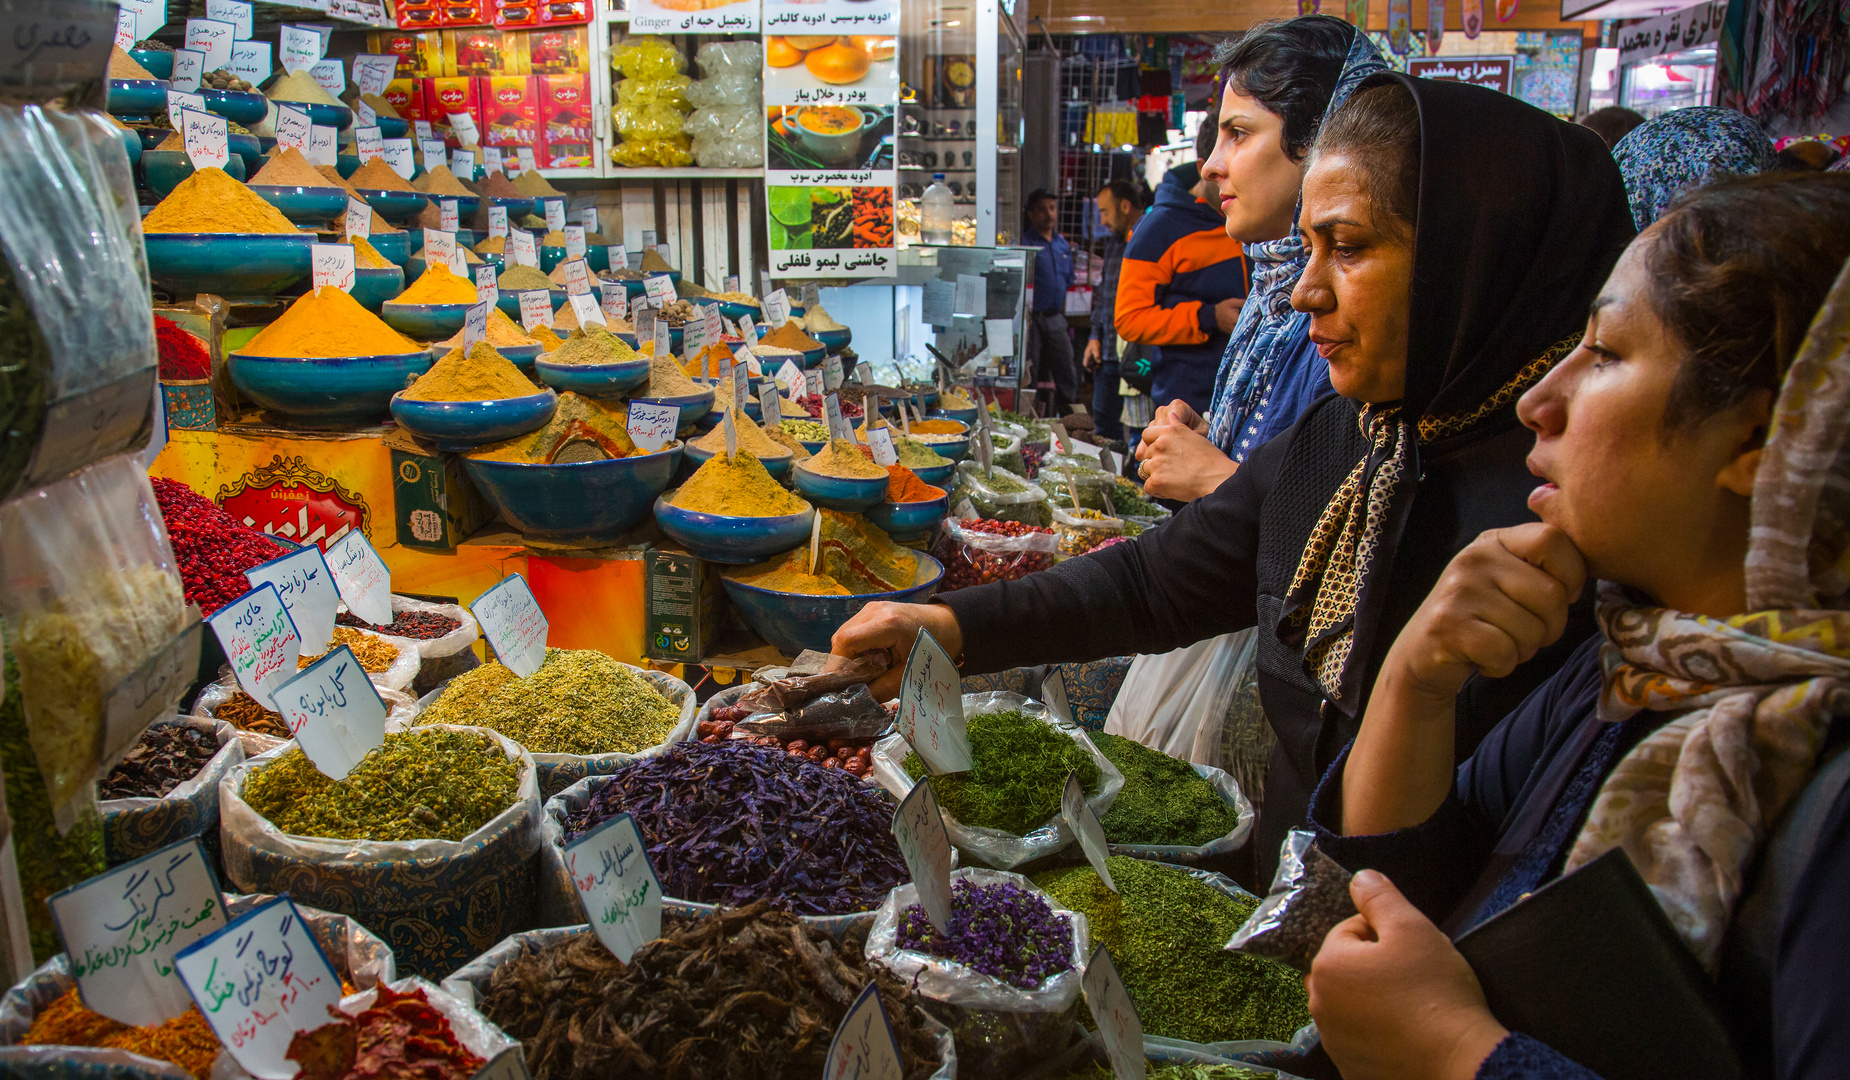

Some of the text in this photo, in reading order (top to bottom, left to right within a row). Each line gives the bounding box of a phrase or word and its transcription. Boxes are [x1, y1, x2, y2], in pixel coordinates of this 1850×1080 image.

[634, 15, 672, 30] Ginger
[680, 13, 752, 30] زنجبیل حبه ای
[768, 12, 892, 26] ادویه سوسیس ادویه کالباس
[1457, 62, 1502, 81] سرای
[794, 88, 810, 103] پیاز
[812, 88, 835, 102] خلال
[838, 92, 843, 102] و
[790, 171, 873, 184] ادویه مخصوص سوپ
[777, 252, 888, 272] چاشنی لیمو فلفلی
[270, 488, 310, 503] زعفران
[346, 541, 366, 562] زرشک
[301, 567, 320, 595] بهار
[243, 601, 264, 628] چای
[299, 661, 348, 717] گل بابونه
[612, 842, 635, 878] سنبل
[103, 851, 194, 932] گلرنگ
[180, 897, 217, 930] جهت
[236, 914, 294, 1008] گوجه فرنگی
[204, 956, 237, 1014] خشک
[279, 971, 299, 1014] گرم
